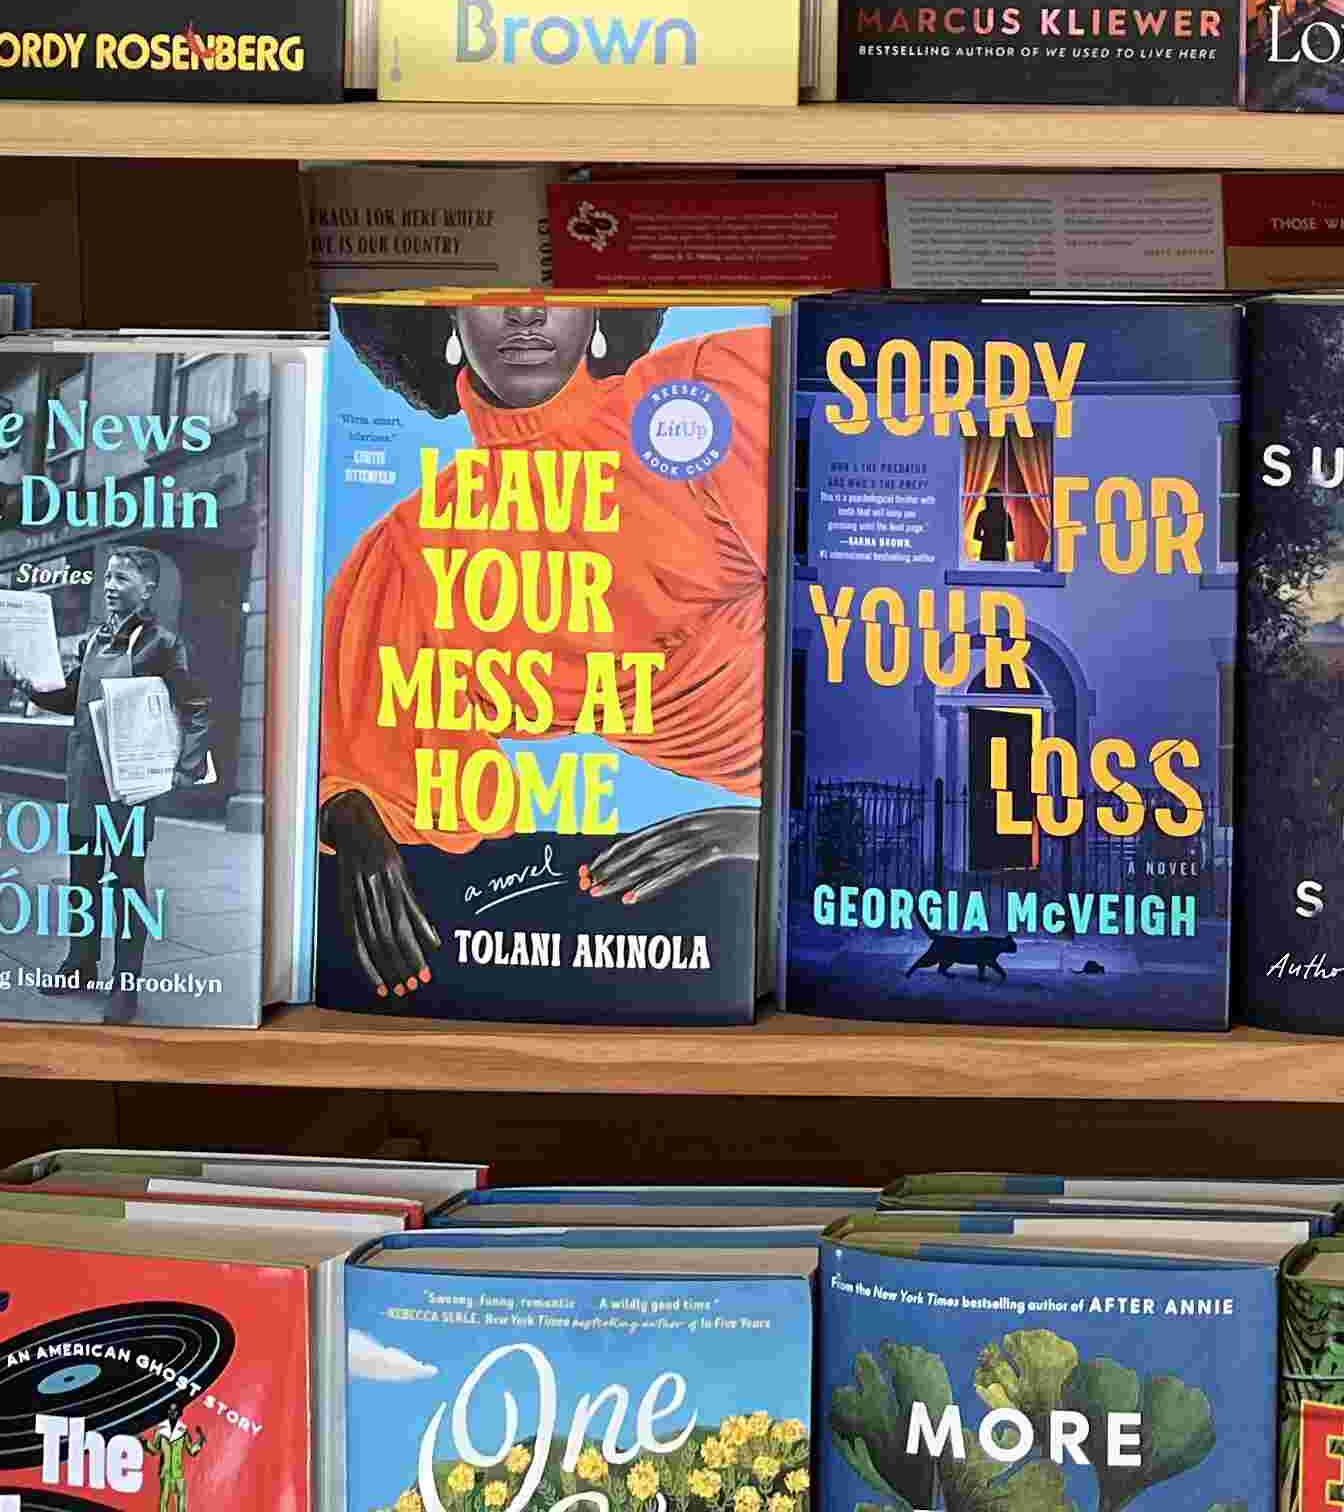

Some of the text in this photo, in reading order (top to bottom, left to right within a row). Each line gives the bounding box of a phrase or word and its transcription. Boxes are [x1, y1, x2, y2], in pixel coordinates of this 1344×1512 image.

[1271, 216, 1318, 232] THOSE
[22, 474, 219, 530] Dublin
[812, 884, 1199, 939] GEORGIA McVEIGH
[453, 928, 711, 970] TOLANI AKINOLA
[1089, 1296, 1234, 1315] AFTER ANNIE
[37, 1343, 263, 1437] AMERICAN GHOST STORY
